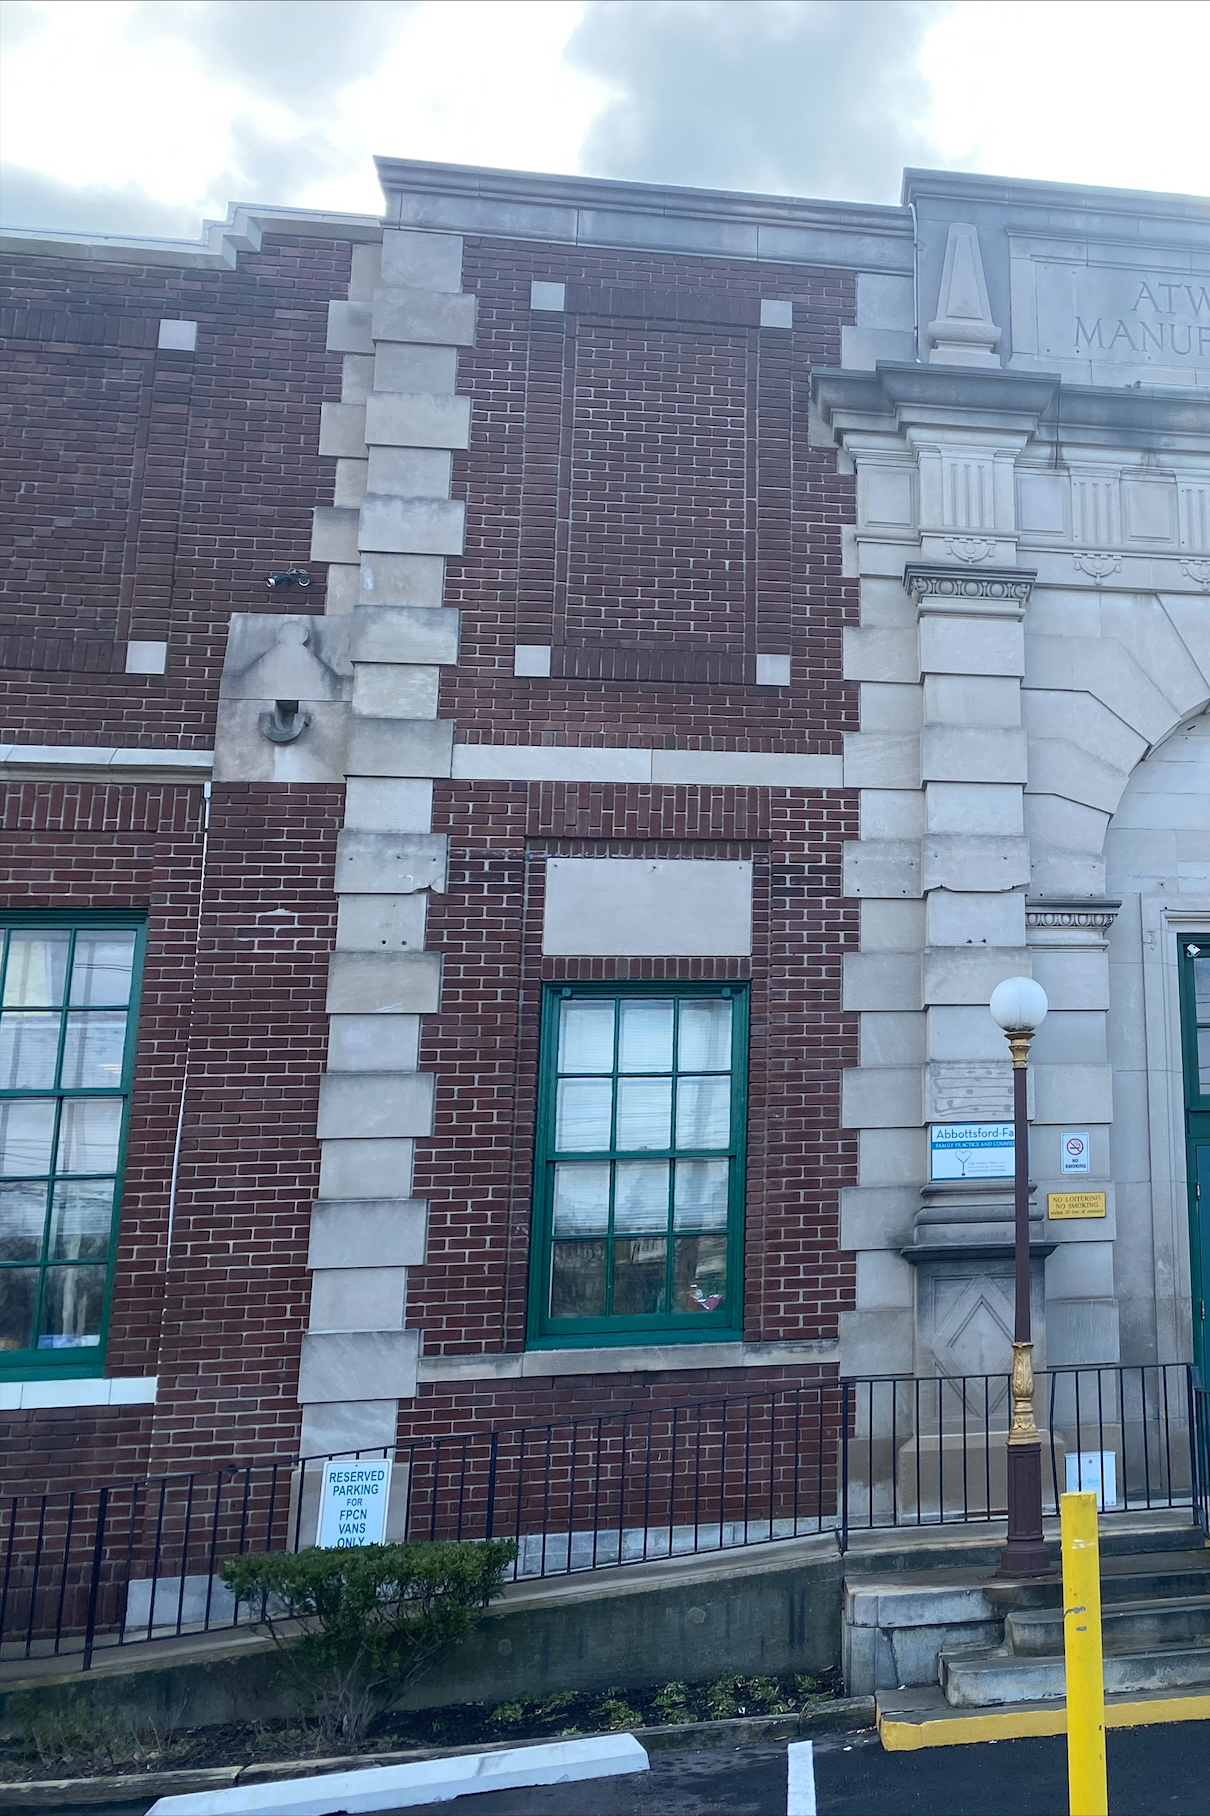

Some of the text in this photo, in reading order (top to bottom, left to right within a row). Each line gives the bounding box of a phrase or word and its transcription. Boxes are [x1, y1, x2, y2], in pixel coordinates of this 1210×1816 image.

[936, 1127, 1014, 1139] Abbottsford-Fa
[329, 1470, 385, 1483] RESERVED
[333, 1484, 378, 1496] PARKING
[346, 1498, 363, 1506] FOR
[340, 1509, 368, 1520] FPCN
[339, 1523, 366, 1534] VANS
[338, 1537, 365, 1548] ONLY
